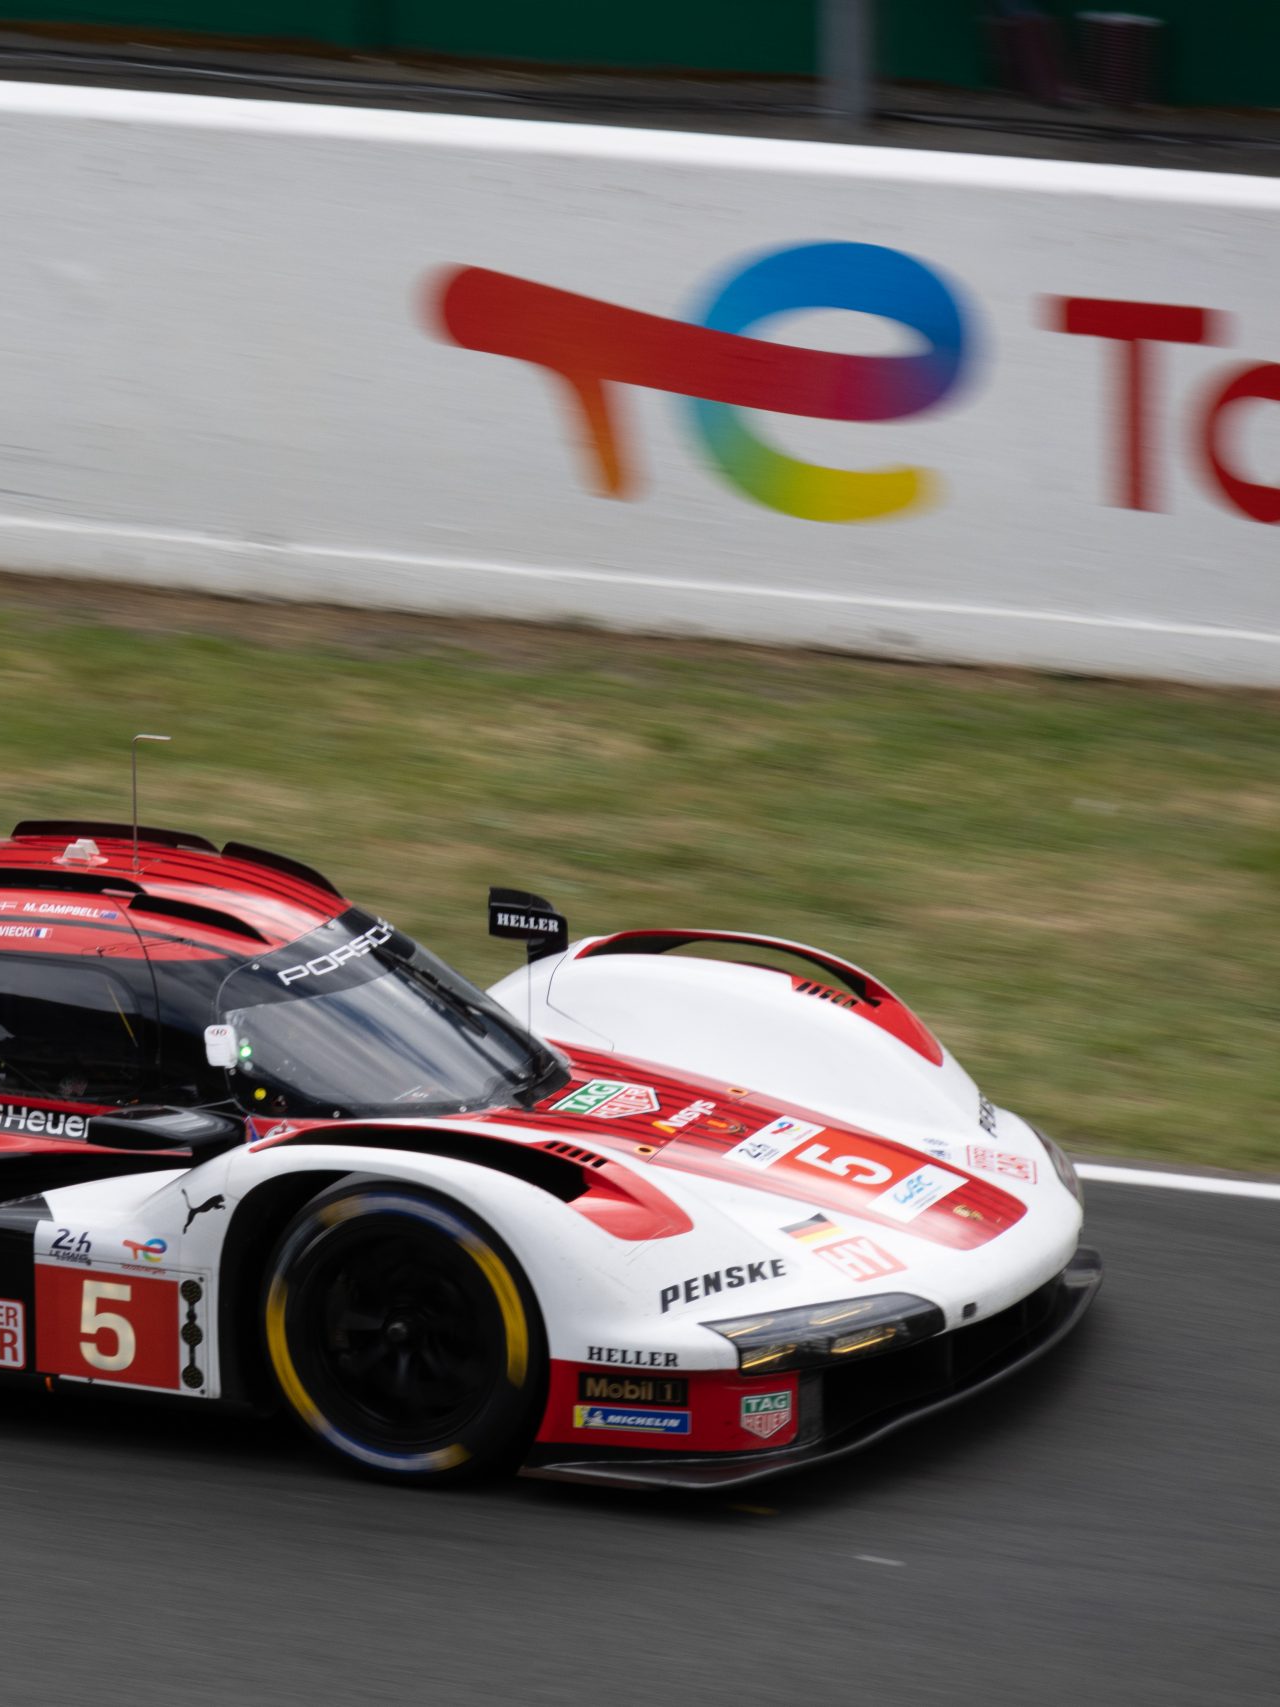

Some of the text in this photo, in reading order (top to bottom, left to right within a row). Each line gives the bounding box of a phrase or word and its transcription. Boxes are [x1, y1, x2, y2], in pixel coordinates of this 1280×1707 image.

[23, 902, 101, 918] M. CAMPBELL
[496, 912, 559, 933] HELLER
[277, 917, 395, 986] PORSCH
[561, 1083, 619, 1112] TAG
[652, 1100, 717, 1134] Ansys
[794, 1142, 893, 1185] 5
[817, 1237, 901, 1281] HY
[659, 1259, 787, 1314] PENSKE
[79, 1279, 136, 1371] 5
[587, 1346, 680, 1367] HELLER
[586, 1377, 677, 1402] Mobil 1
[747, 1394, 789, 1413] TAG
[606, 1414, 681, 1428] MICHELIN
[744, 1411, 790, 1437] HEUER
